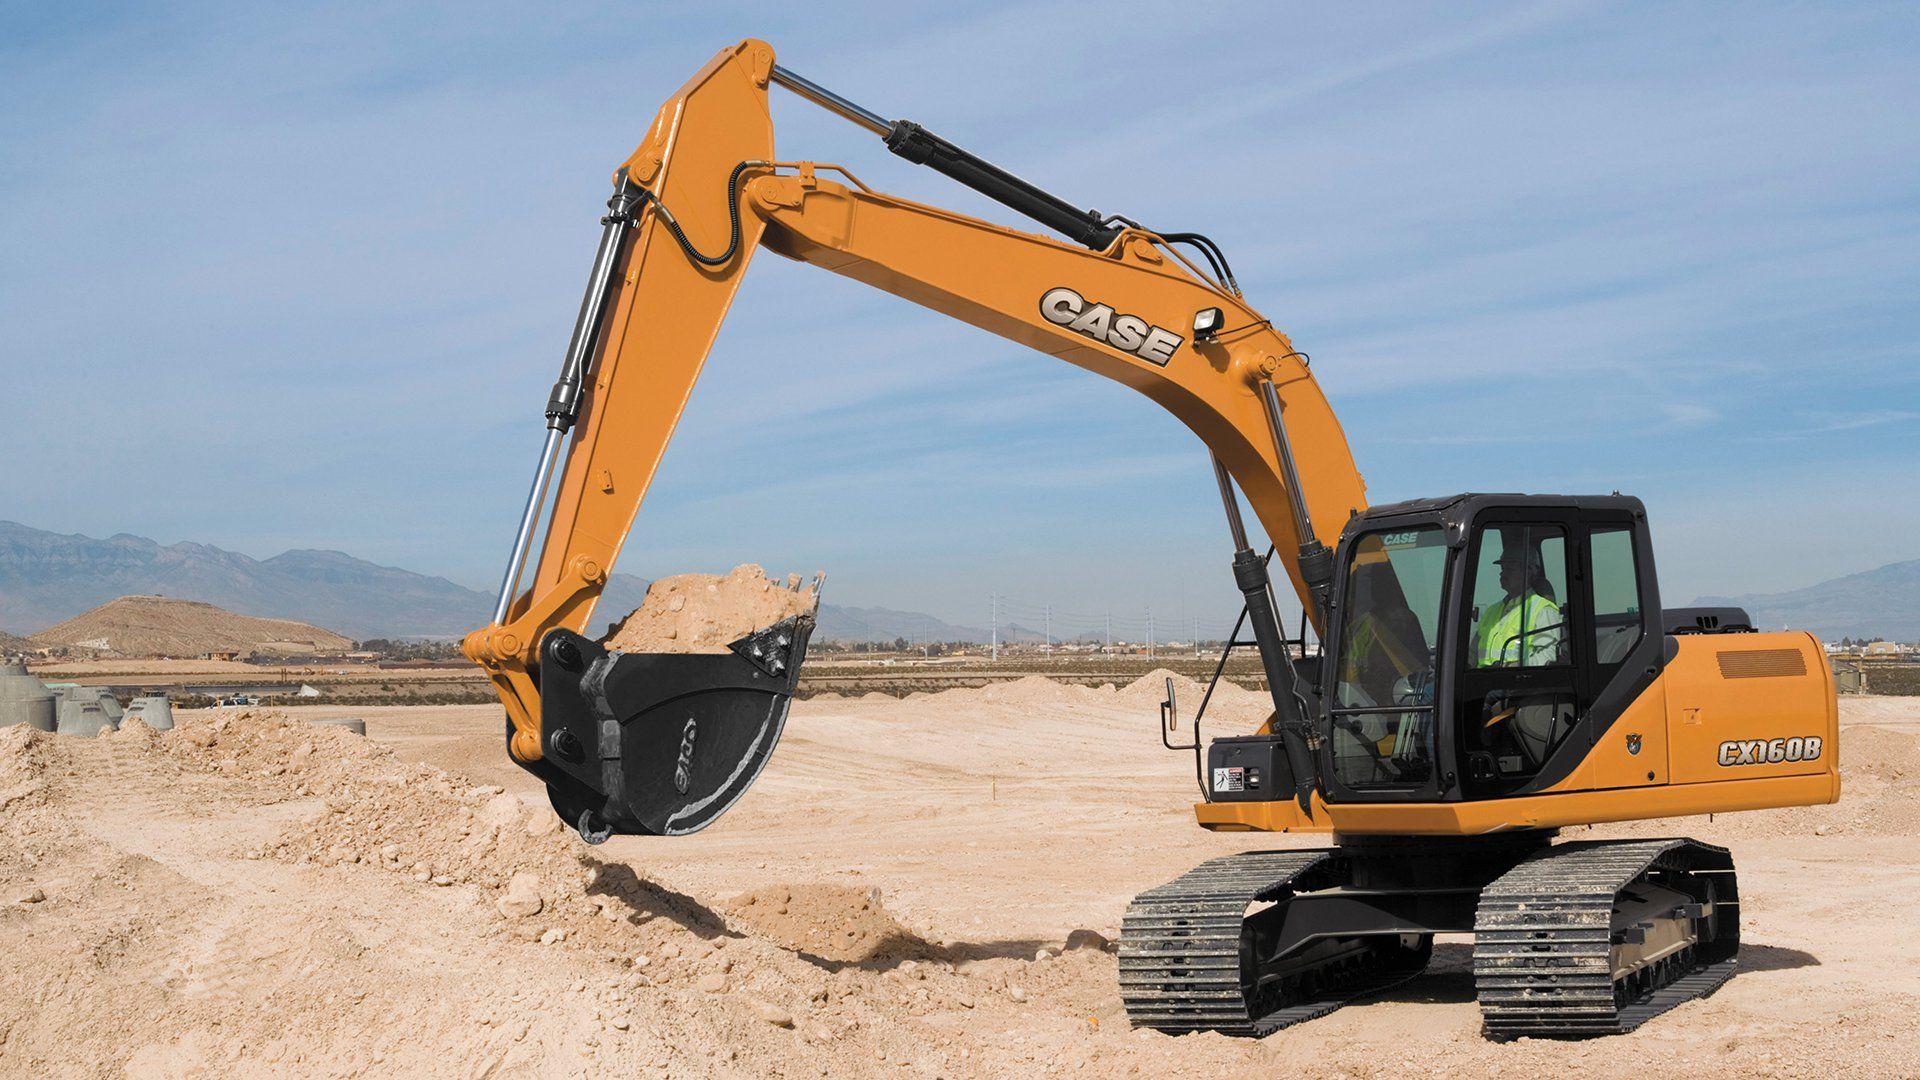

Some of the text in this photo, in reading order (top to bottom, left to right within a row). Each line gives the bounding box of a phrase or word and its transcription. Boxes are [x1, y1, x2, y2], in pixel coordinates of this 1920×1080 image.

[1040, 287, 1185, 367] CASE
[1384, 532, 1418, 545] CASE
[1718, 736, 1822, 766] CX160B
